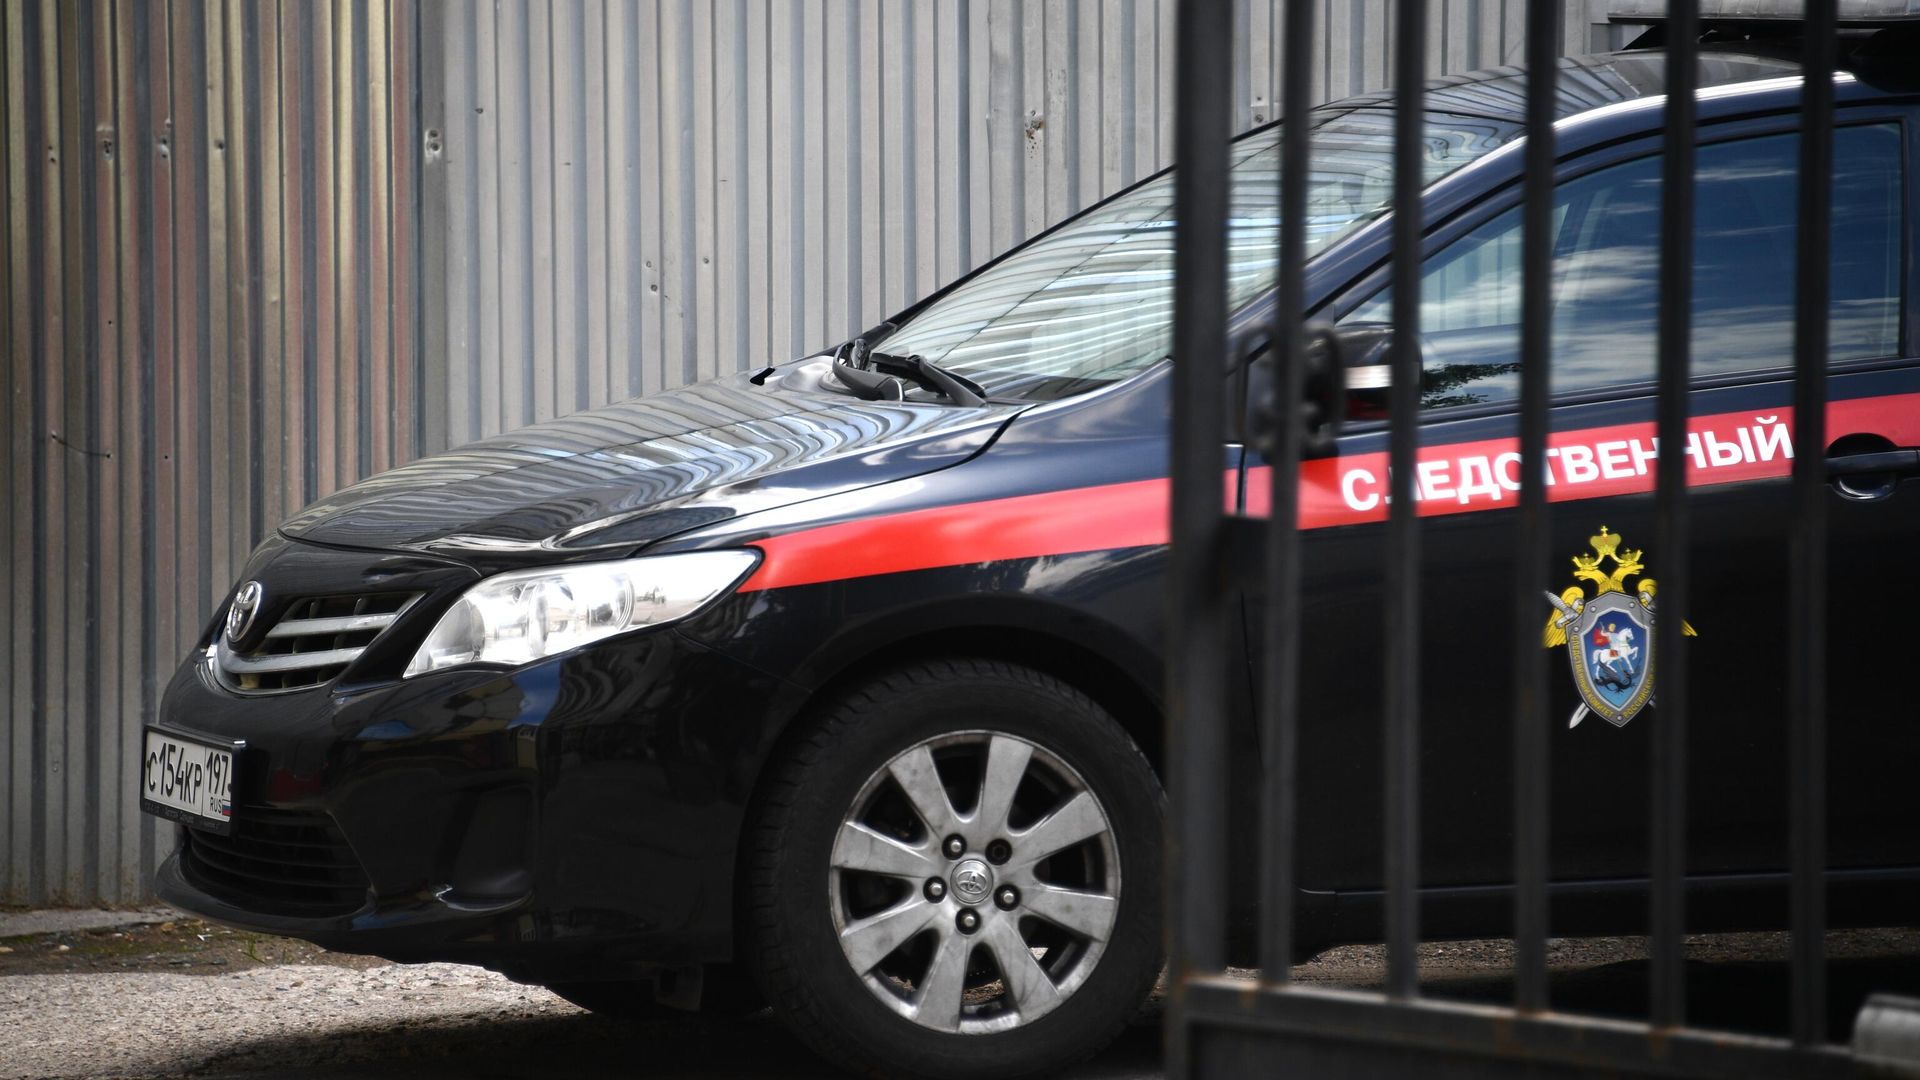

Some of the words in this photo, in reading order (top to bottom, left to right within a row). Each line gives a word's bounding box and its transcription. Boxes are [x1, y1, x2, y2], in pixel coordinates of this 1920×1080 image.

[148, 742, 202, 804] С154КР
[206, 751, 229, 796] 197
[210, 797, 222, 813] RUS
